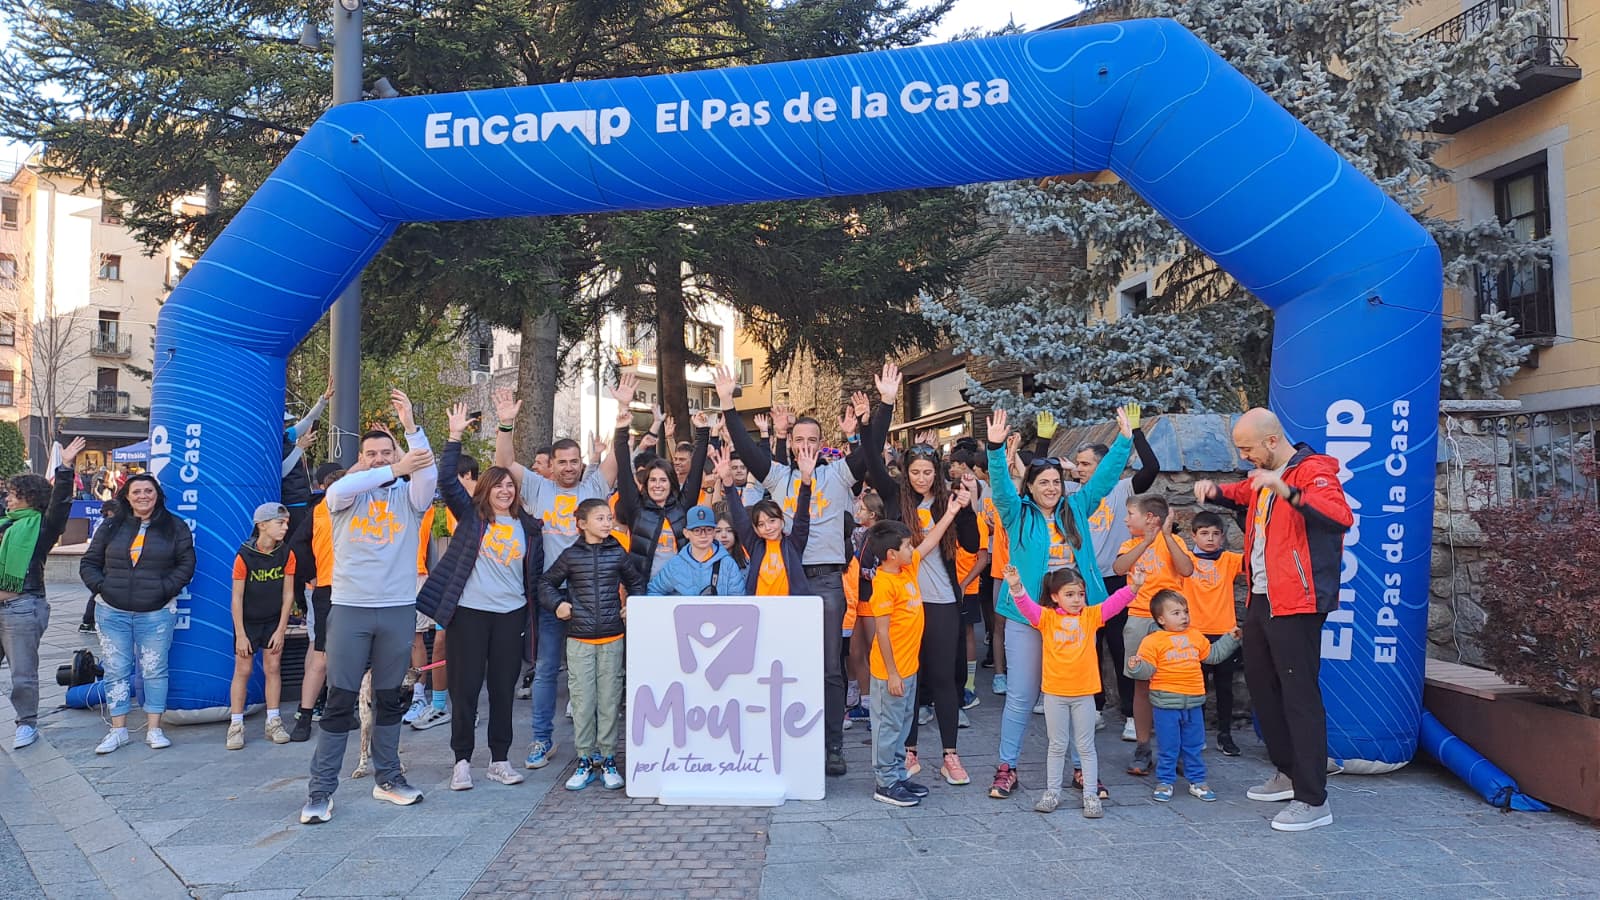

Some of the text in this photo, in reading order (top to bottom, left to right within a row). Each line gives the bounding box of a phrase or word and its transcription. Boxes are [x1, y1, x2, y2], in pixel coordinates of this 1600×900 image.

[425, 78, 1010, 149] Encamp El Pas de la Casa
[179, 423, 202, 483] Casa
[177, 489, 198, 511] la
[1374, 400, 1410, 663] El Pas de la Casa
[250, 566, 284, 582] NIKE
[174, 608, 191, 630] El
[633, 747, 768, 782] per la teva salut
